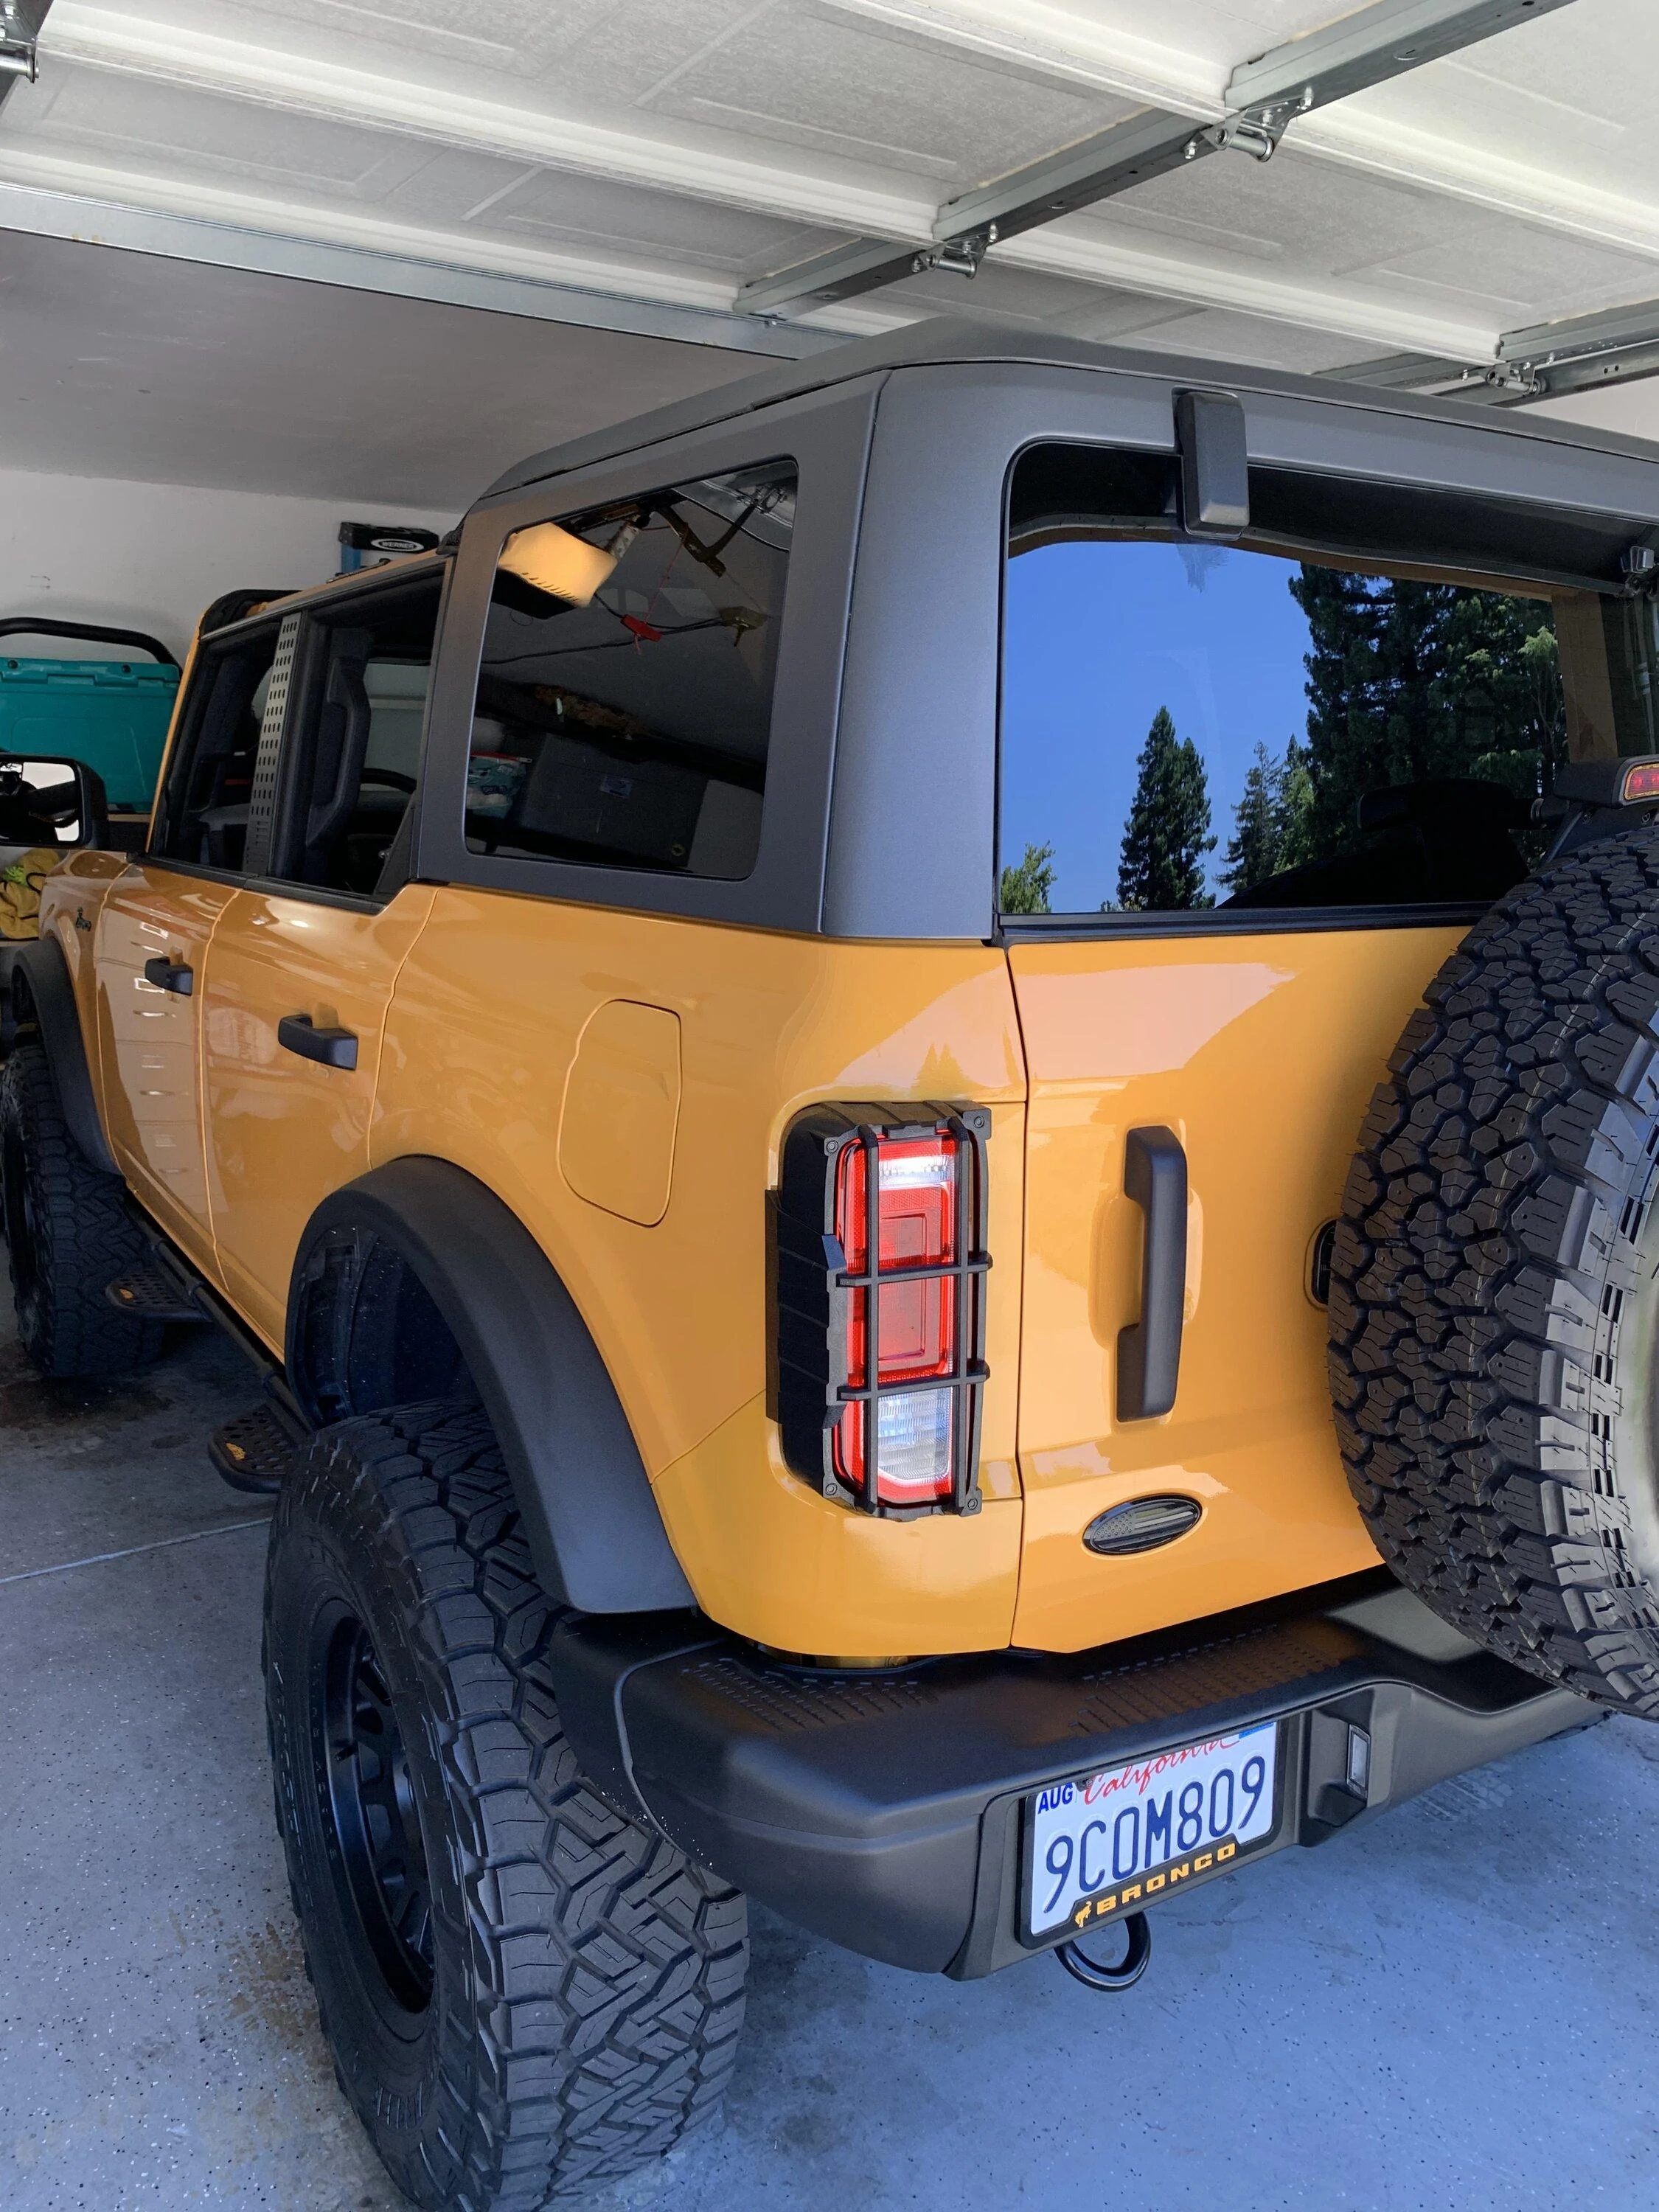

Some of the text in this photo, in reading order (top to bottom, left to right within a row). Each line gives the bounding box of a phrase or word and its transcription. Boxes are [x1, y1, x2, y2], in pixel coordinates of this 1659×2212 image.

[1037, 1782, 1074, 1815] AUG
[1043, 1756, 1266, 1914] 9COM809
[1096, 1843, 1237, 1916] BRONCO
